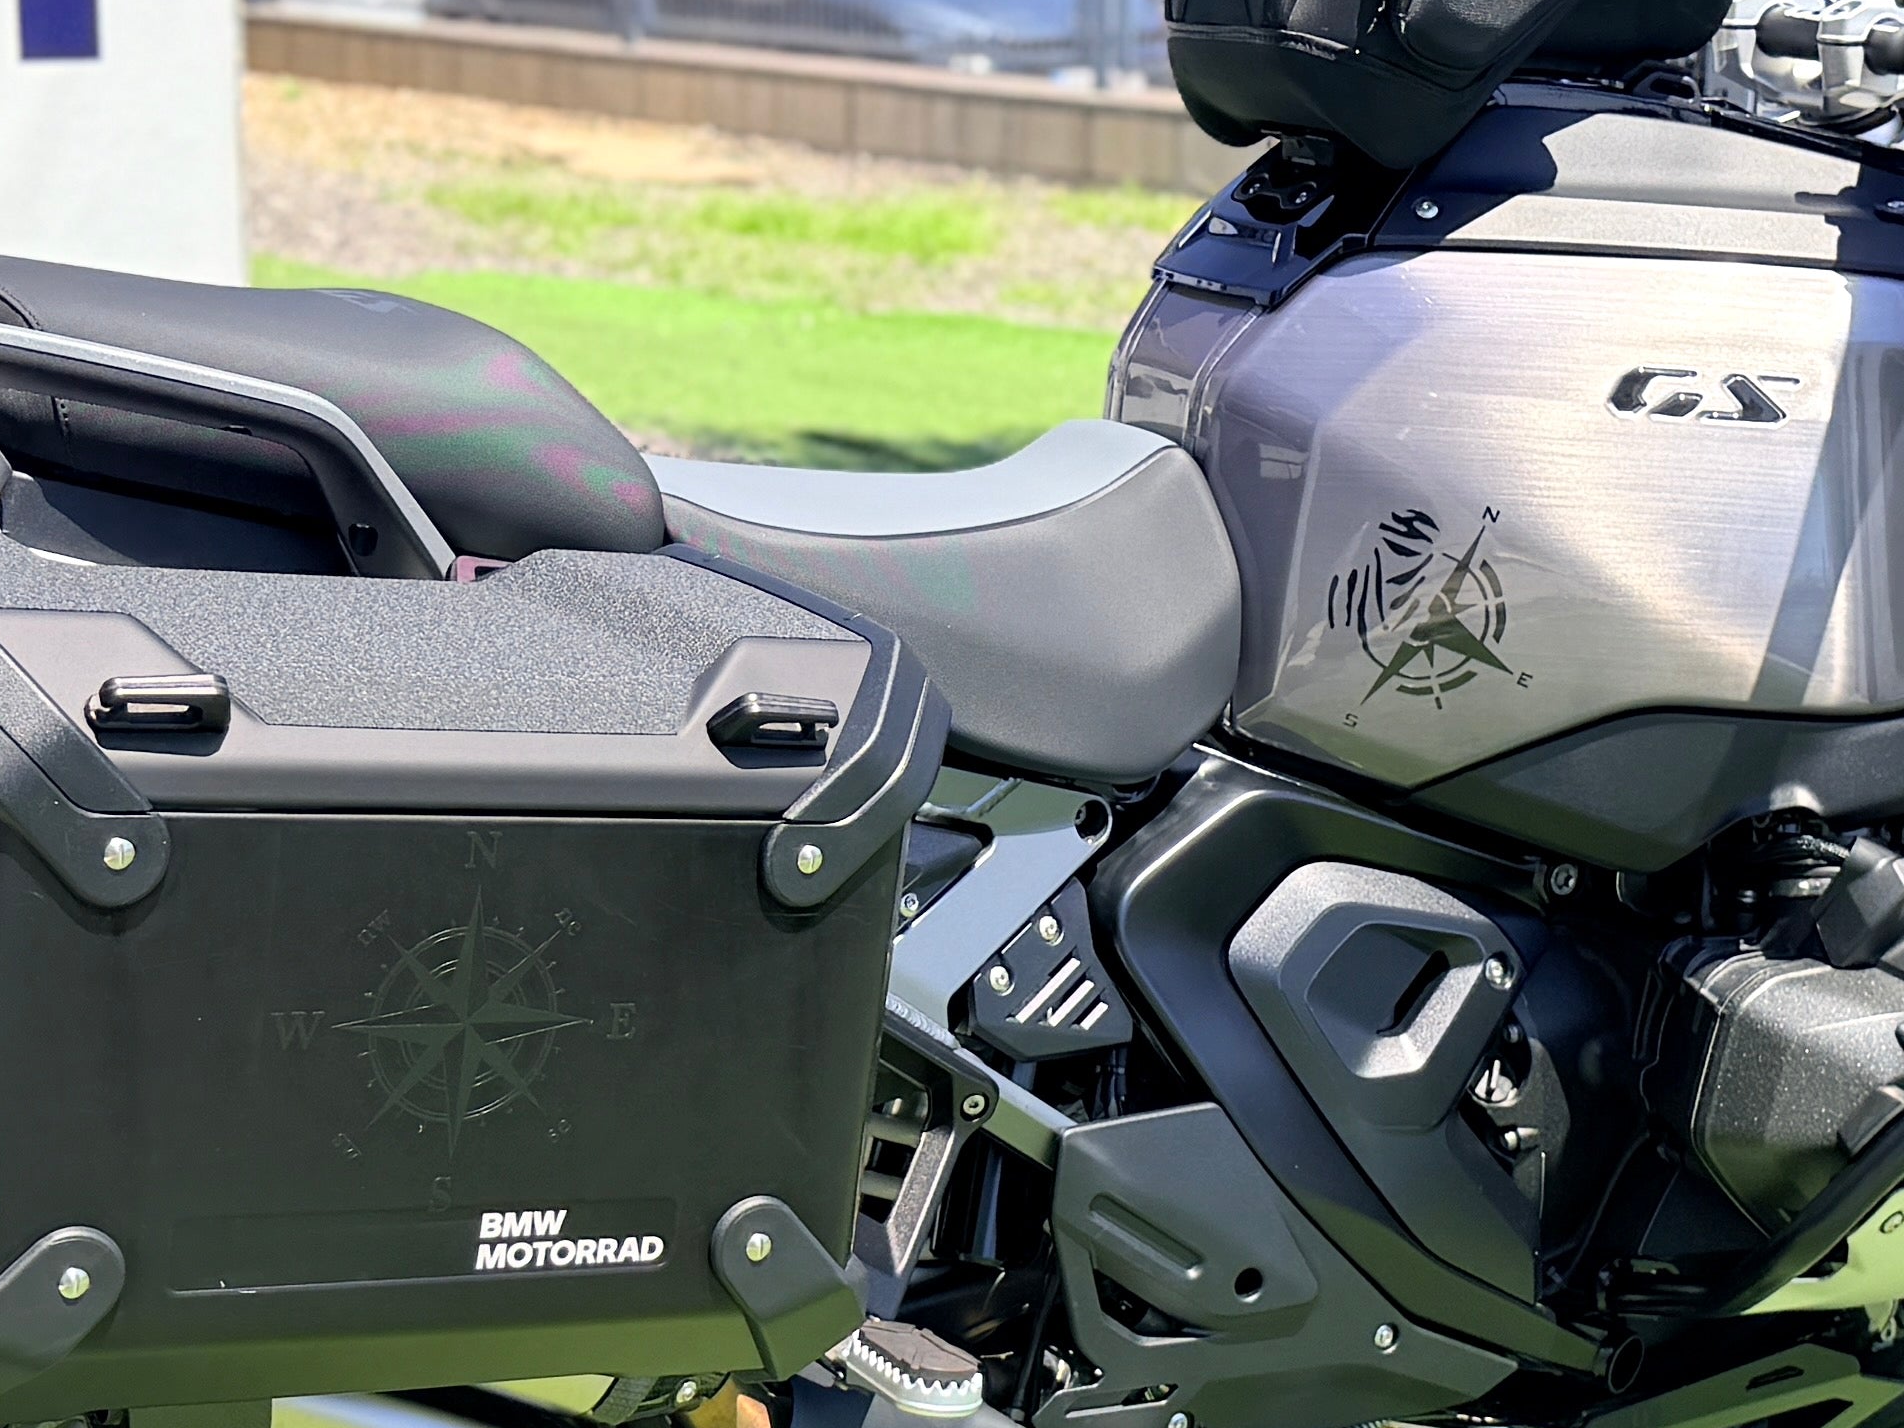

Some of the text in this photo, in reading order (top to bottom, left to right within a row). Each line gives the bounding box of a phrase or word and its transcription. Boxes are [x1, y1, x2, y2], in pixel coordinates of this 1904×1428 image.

[1606, 365, 1805, 429] GS
[1482, 506, 1500, 523] N
[1516, 673, 1533, 689] E
[464, 830, 503, 869] N
[268, 1010, 326, 1051] W
[605, 1001, 638, 1041] E
[428, 1175, 453, 1213] S
[479, 1209, 568, 1239] BMW
[474, 1235, 665, 1270] MOTORRAD
